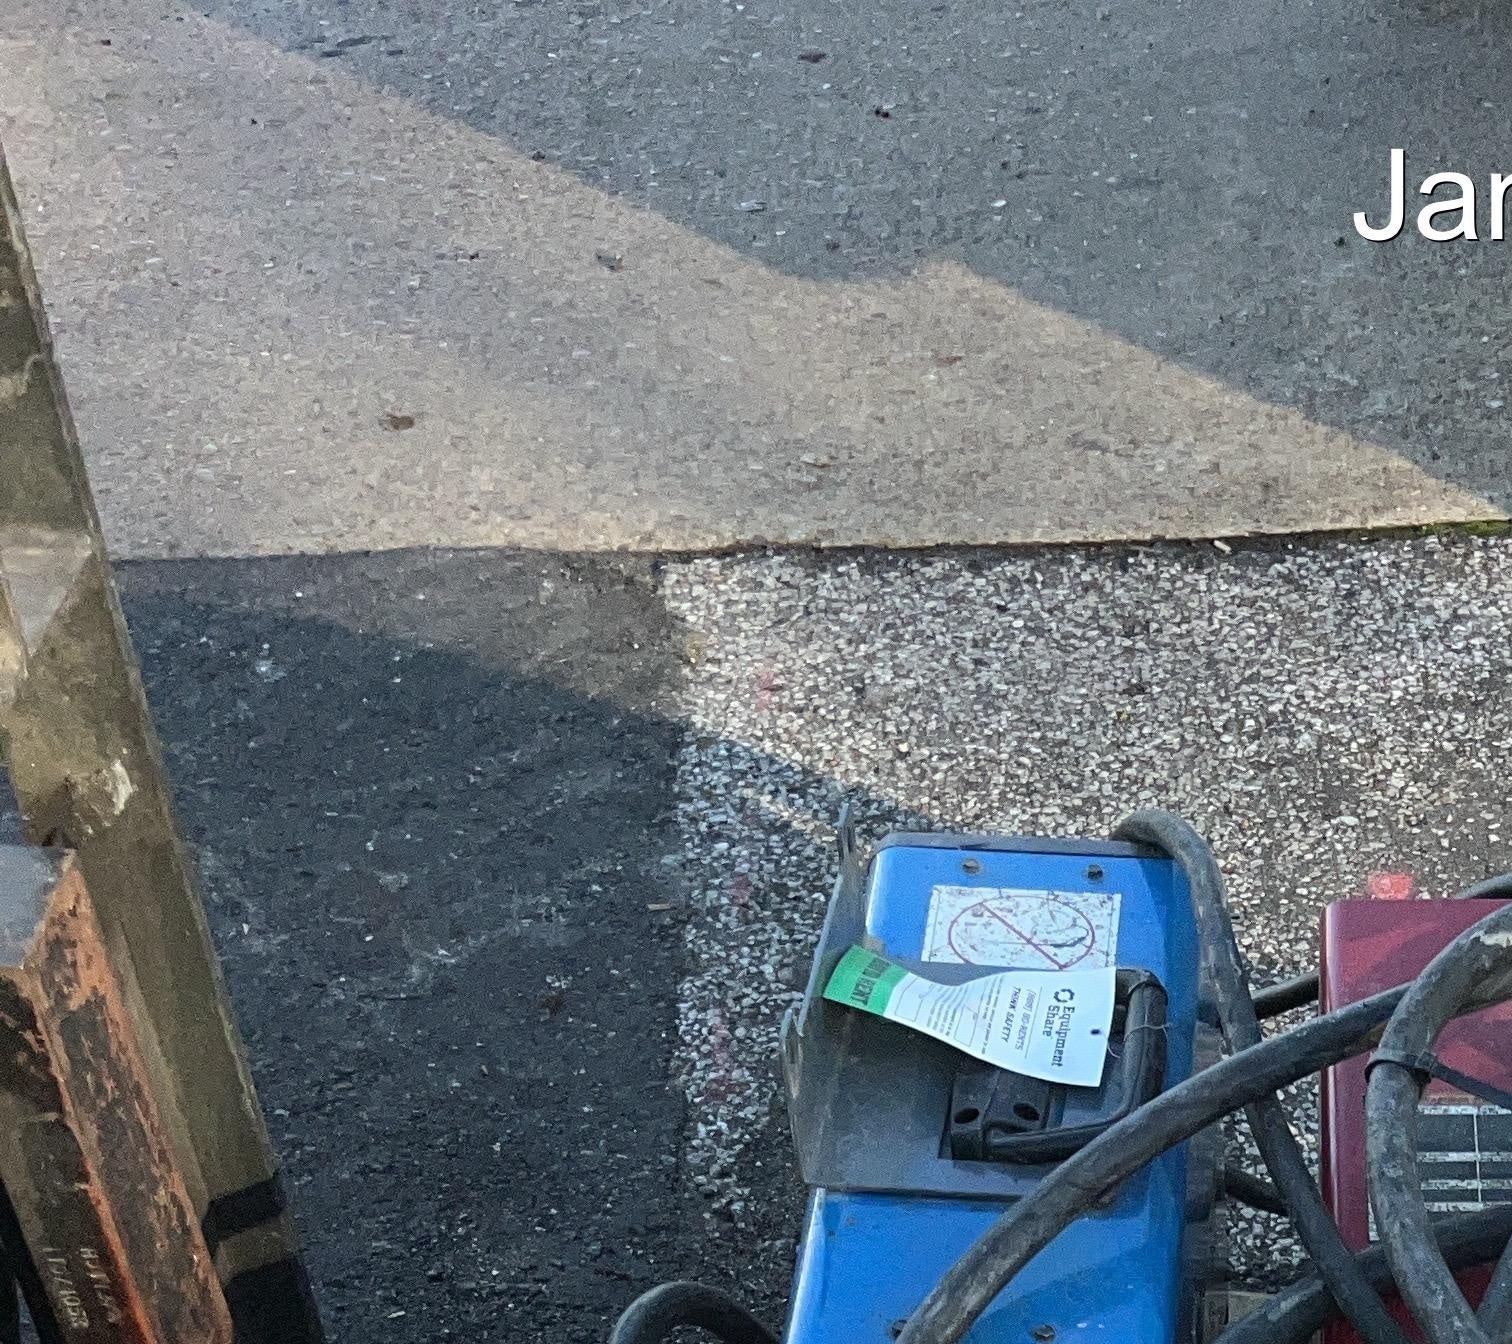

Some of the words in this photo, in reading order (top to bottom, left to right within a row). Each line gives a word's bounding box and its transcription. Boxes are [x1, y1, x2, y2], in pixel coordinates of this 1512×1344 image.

[1009, 987, 1021, 1012] THINK
[1000, 1012, 1016, 1043] SAFETY
[1043, 1005, 1059, 1037] Share
[1050, 1006, 1076, 1067] Equipment
